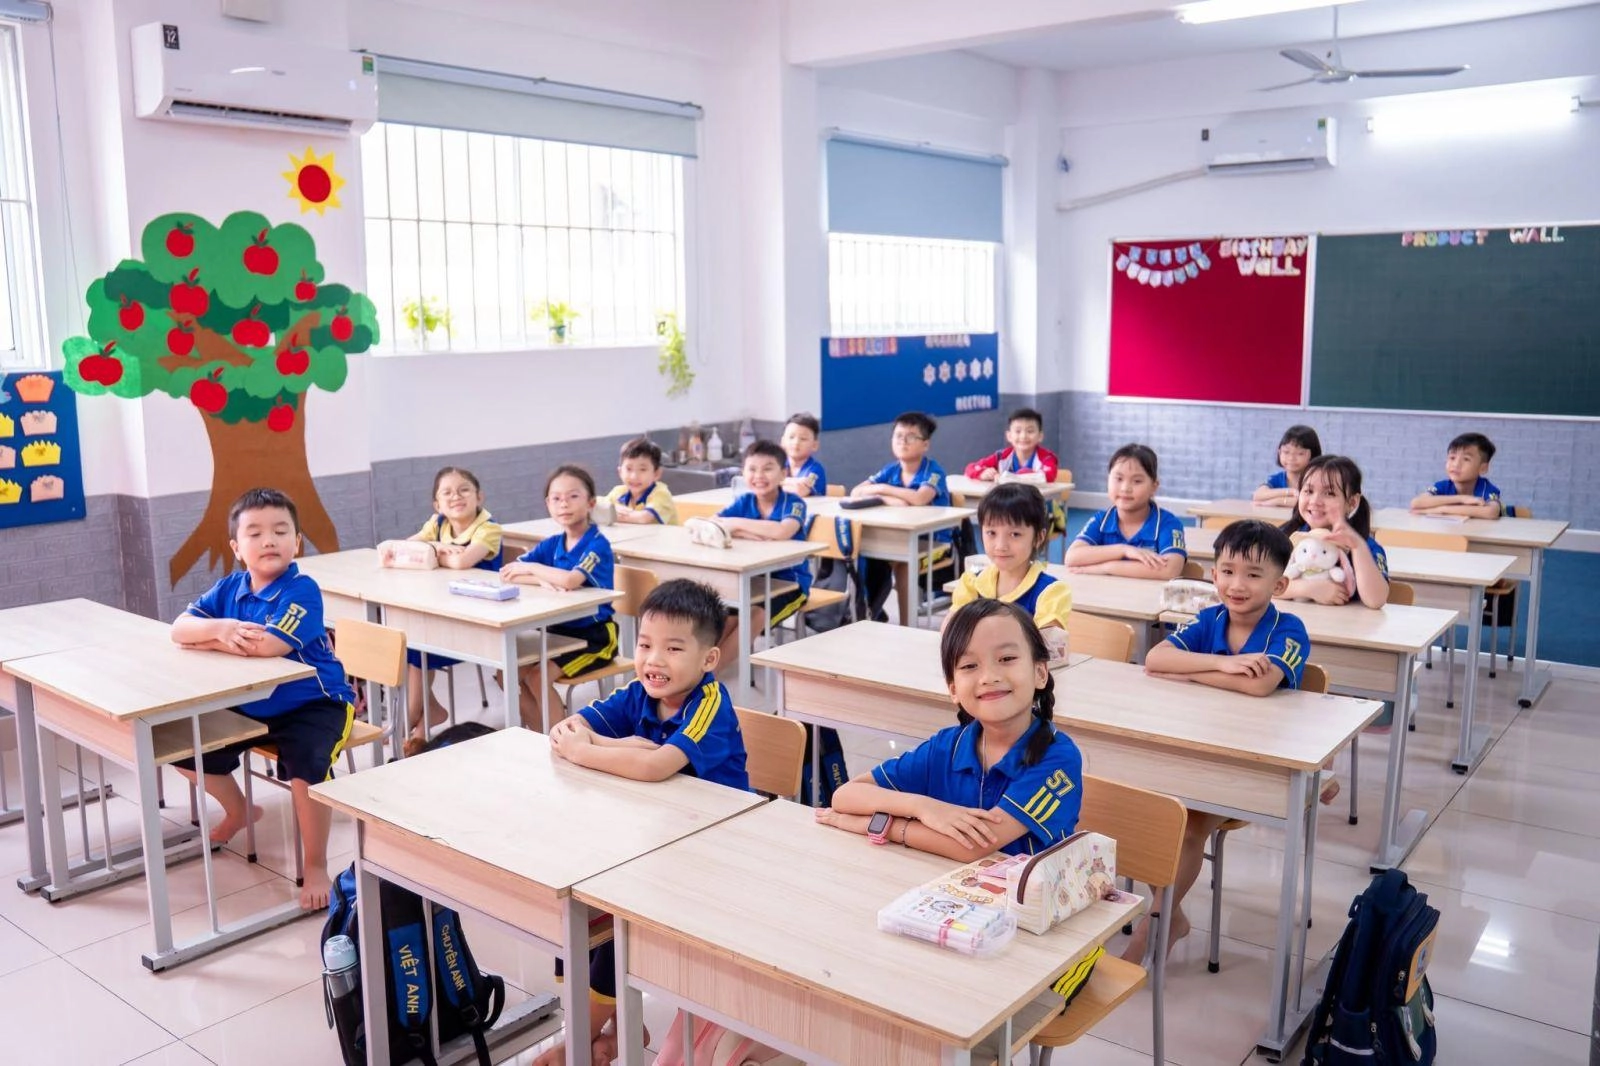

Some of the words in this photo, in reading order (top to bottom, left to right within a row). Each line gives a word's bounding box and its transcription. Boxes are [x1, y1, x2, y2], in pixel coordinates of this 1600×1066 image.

[1402, 230, 1488, 247] PRODUCT
[1509, 226, 1565, 243] WALL
[1237, 256, 1300, 276] WALL
[1046, 768, 1075, 797] 57
[399, 944, 420, 977] VIỆT
[441, 925, 457, 969] CHUYÊN
[451, 970, 466, 991] ANH
[406, 983, 419, 1014] ANH
